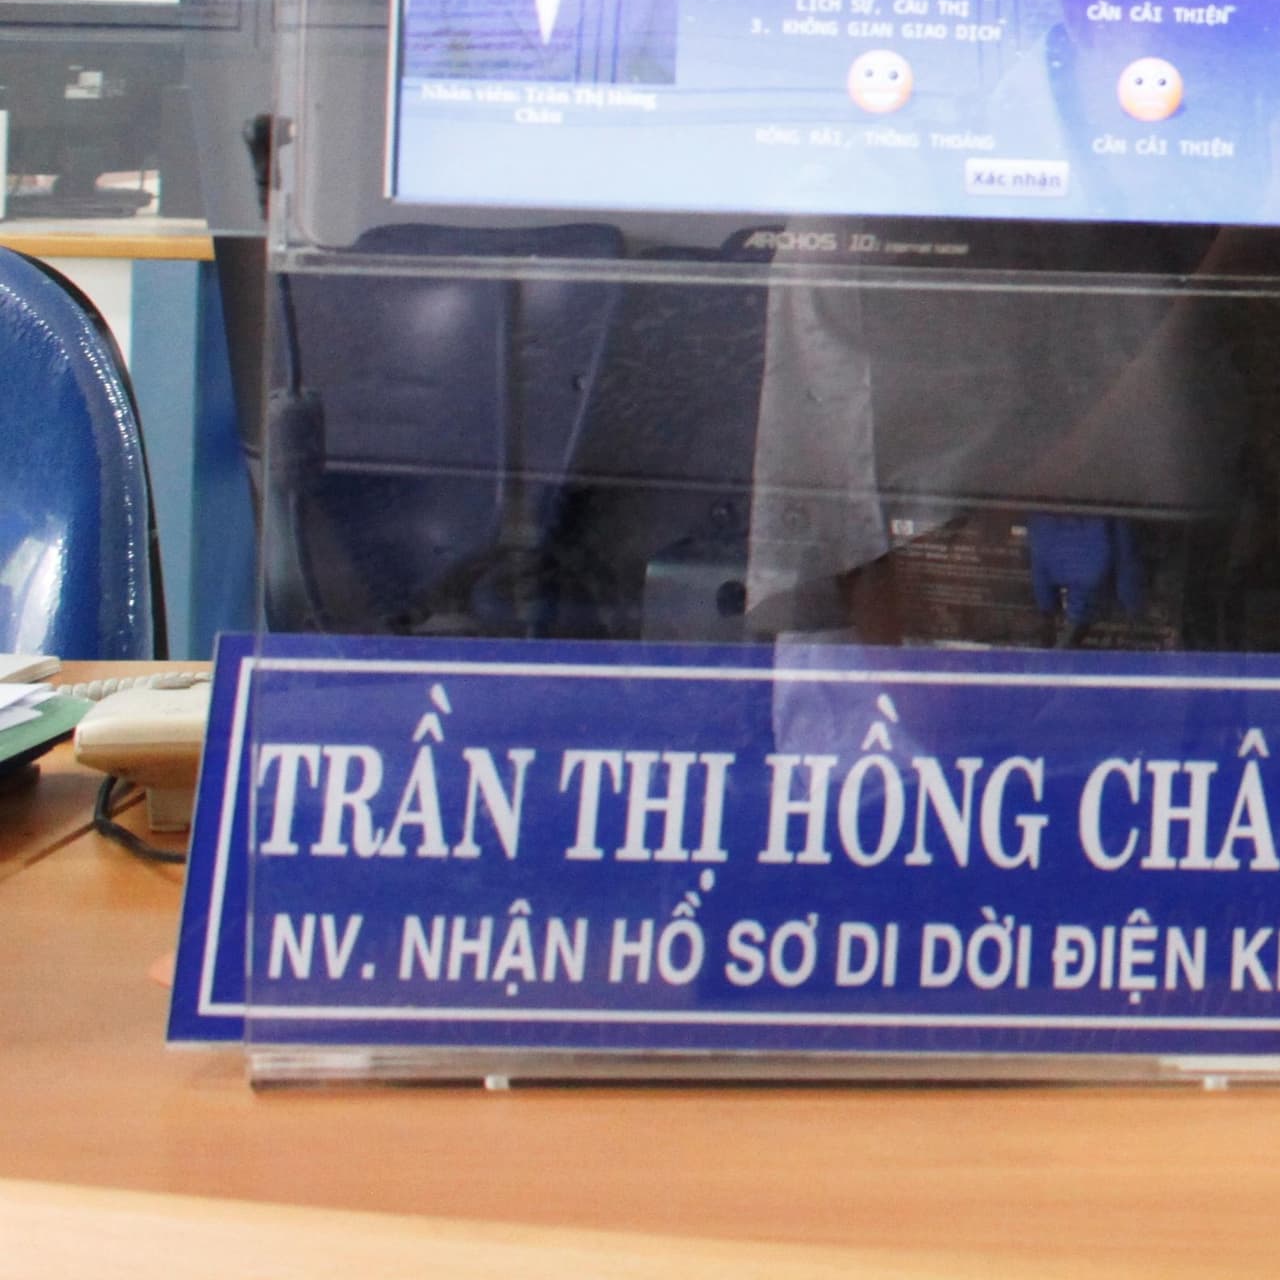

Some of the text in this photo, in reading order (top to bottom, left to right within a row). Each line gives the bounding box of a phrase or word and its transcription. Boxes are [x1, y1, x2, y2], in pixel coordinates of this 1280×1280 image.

[1086, 0, 1230, 26] CẦN CẢI THIỆN
[847, 20, 895, 40] GIAN
[902, 21, 949, 42] GIAO
[1092, 134, 1234, 159] CẦN CẢI THIỆN
[973, 166, 1062, 191] Xác nhận
[743, 231, 838, 251] ARCHOS
[257, 684, 535, 860] TRẦN
[560, 748, 734, 892] THỊ
[758, 694, 1048, 870] HỒNG
[268, 913, 377, 982] NV.
[400, 901, 586, 997] NHẬN
[608, 892, 705, 986] HỒ
[725, 913, 820, 989] SƠ
[835, 924, 900, 989] DI
[918, 907, 1032, 992] DỜI
[1053, 907, 1208, 1005] ĐIỆN
